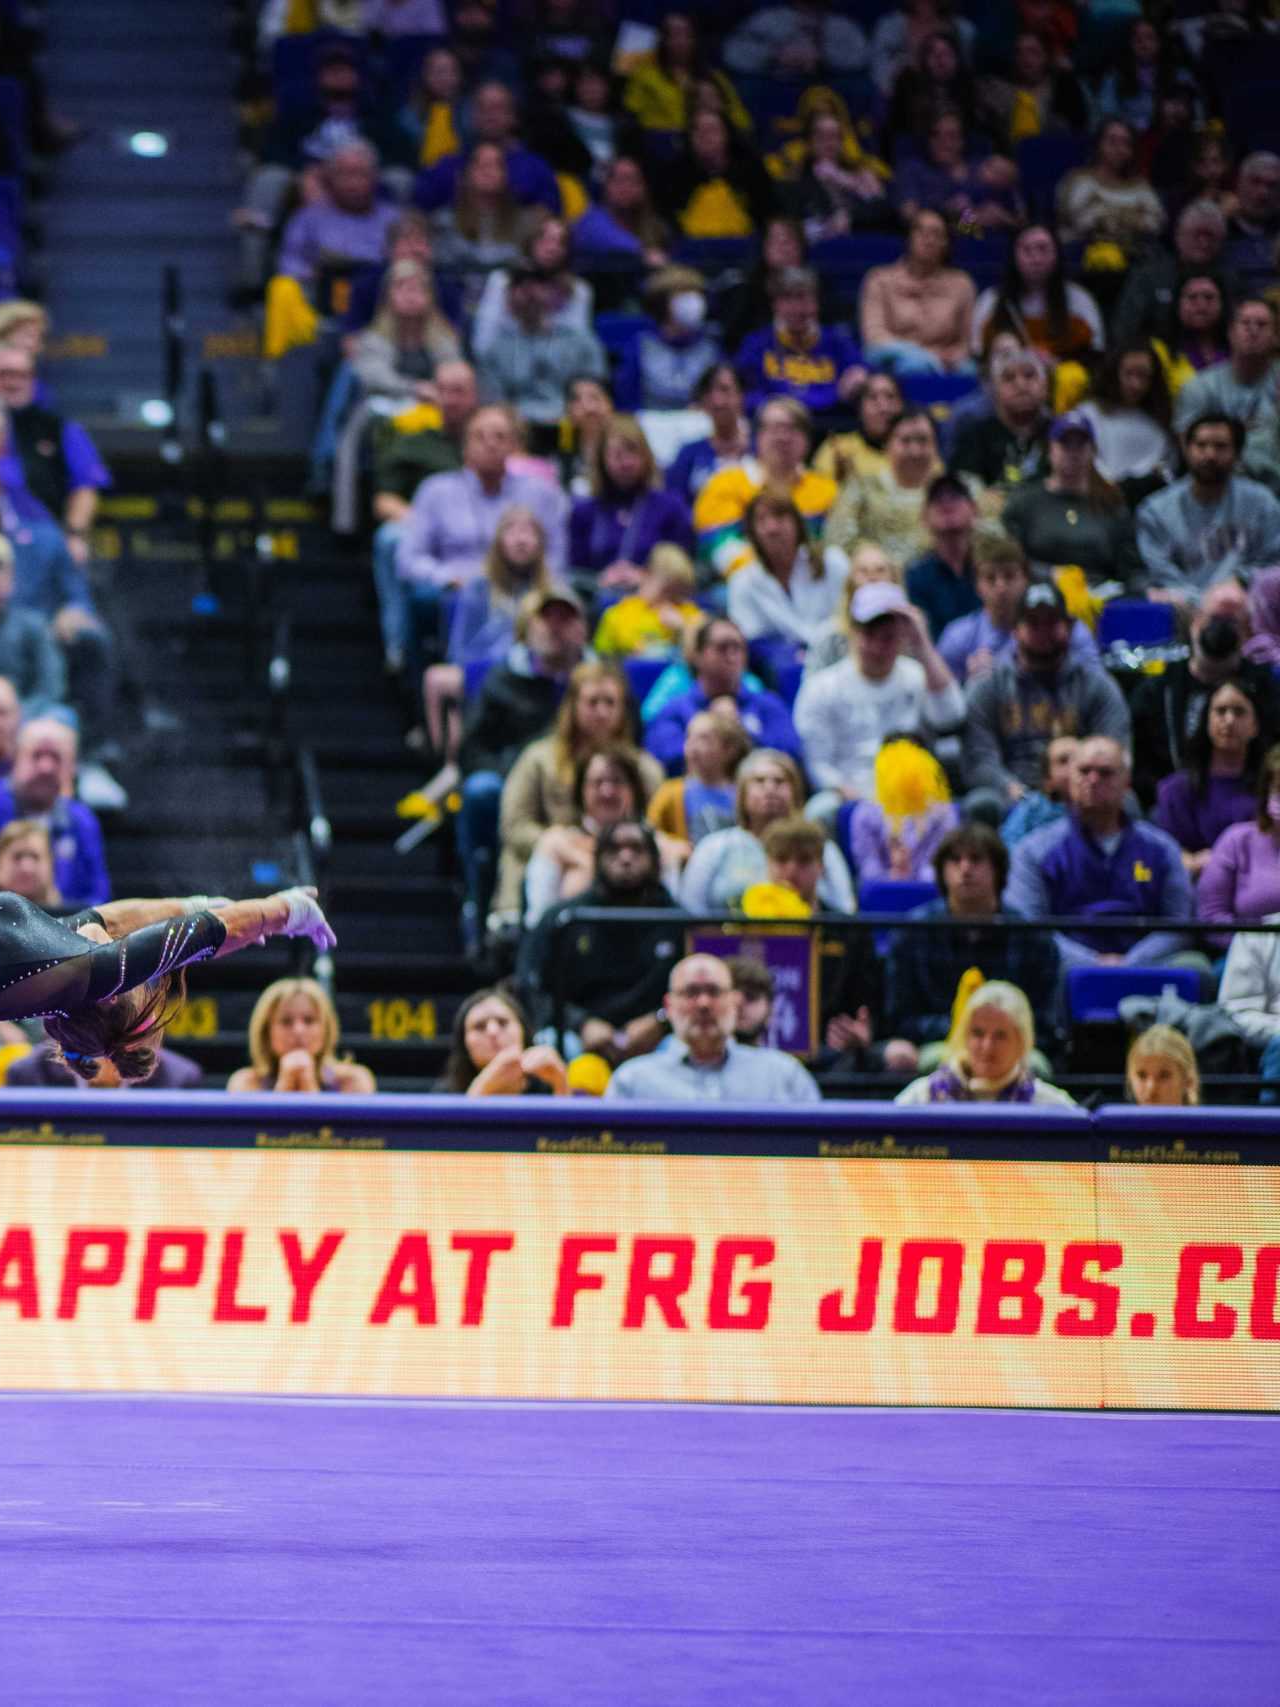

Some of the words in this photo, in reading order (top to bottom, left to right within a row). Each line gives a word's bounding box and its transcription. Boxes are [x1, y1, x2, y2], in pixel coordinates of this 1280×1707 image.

[369, 999, 436, 1039] 104
[368, 1229, 515, 1327] AT
[550, 1232, 776, 1332] FRG
